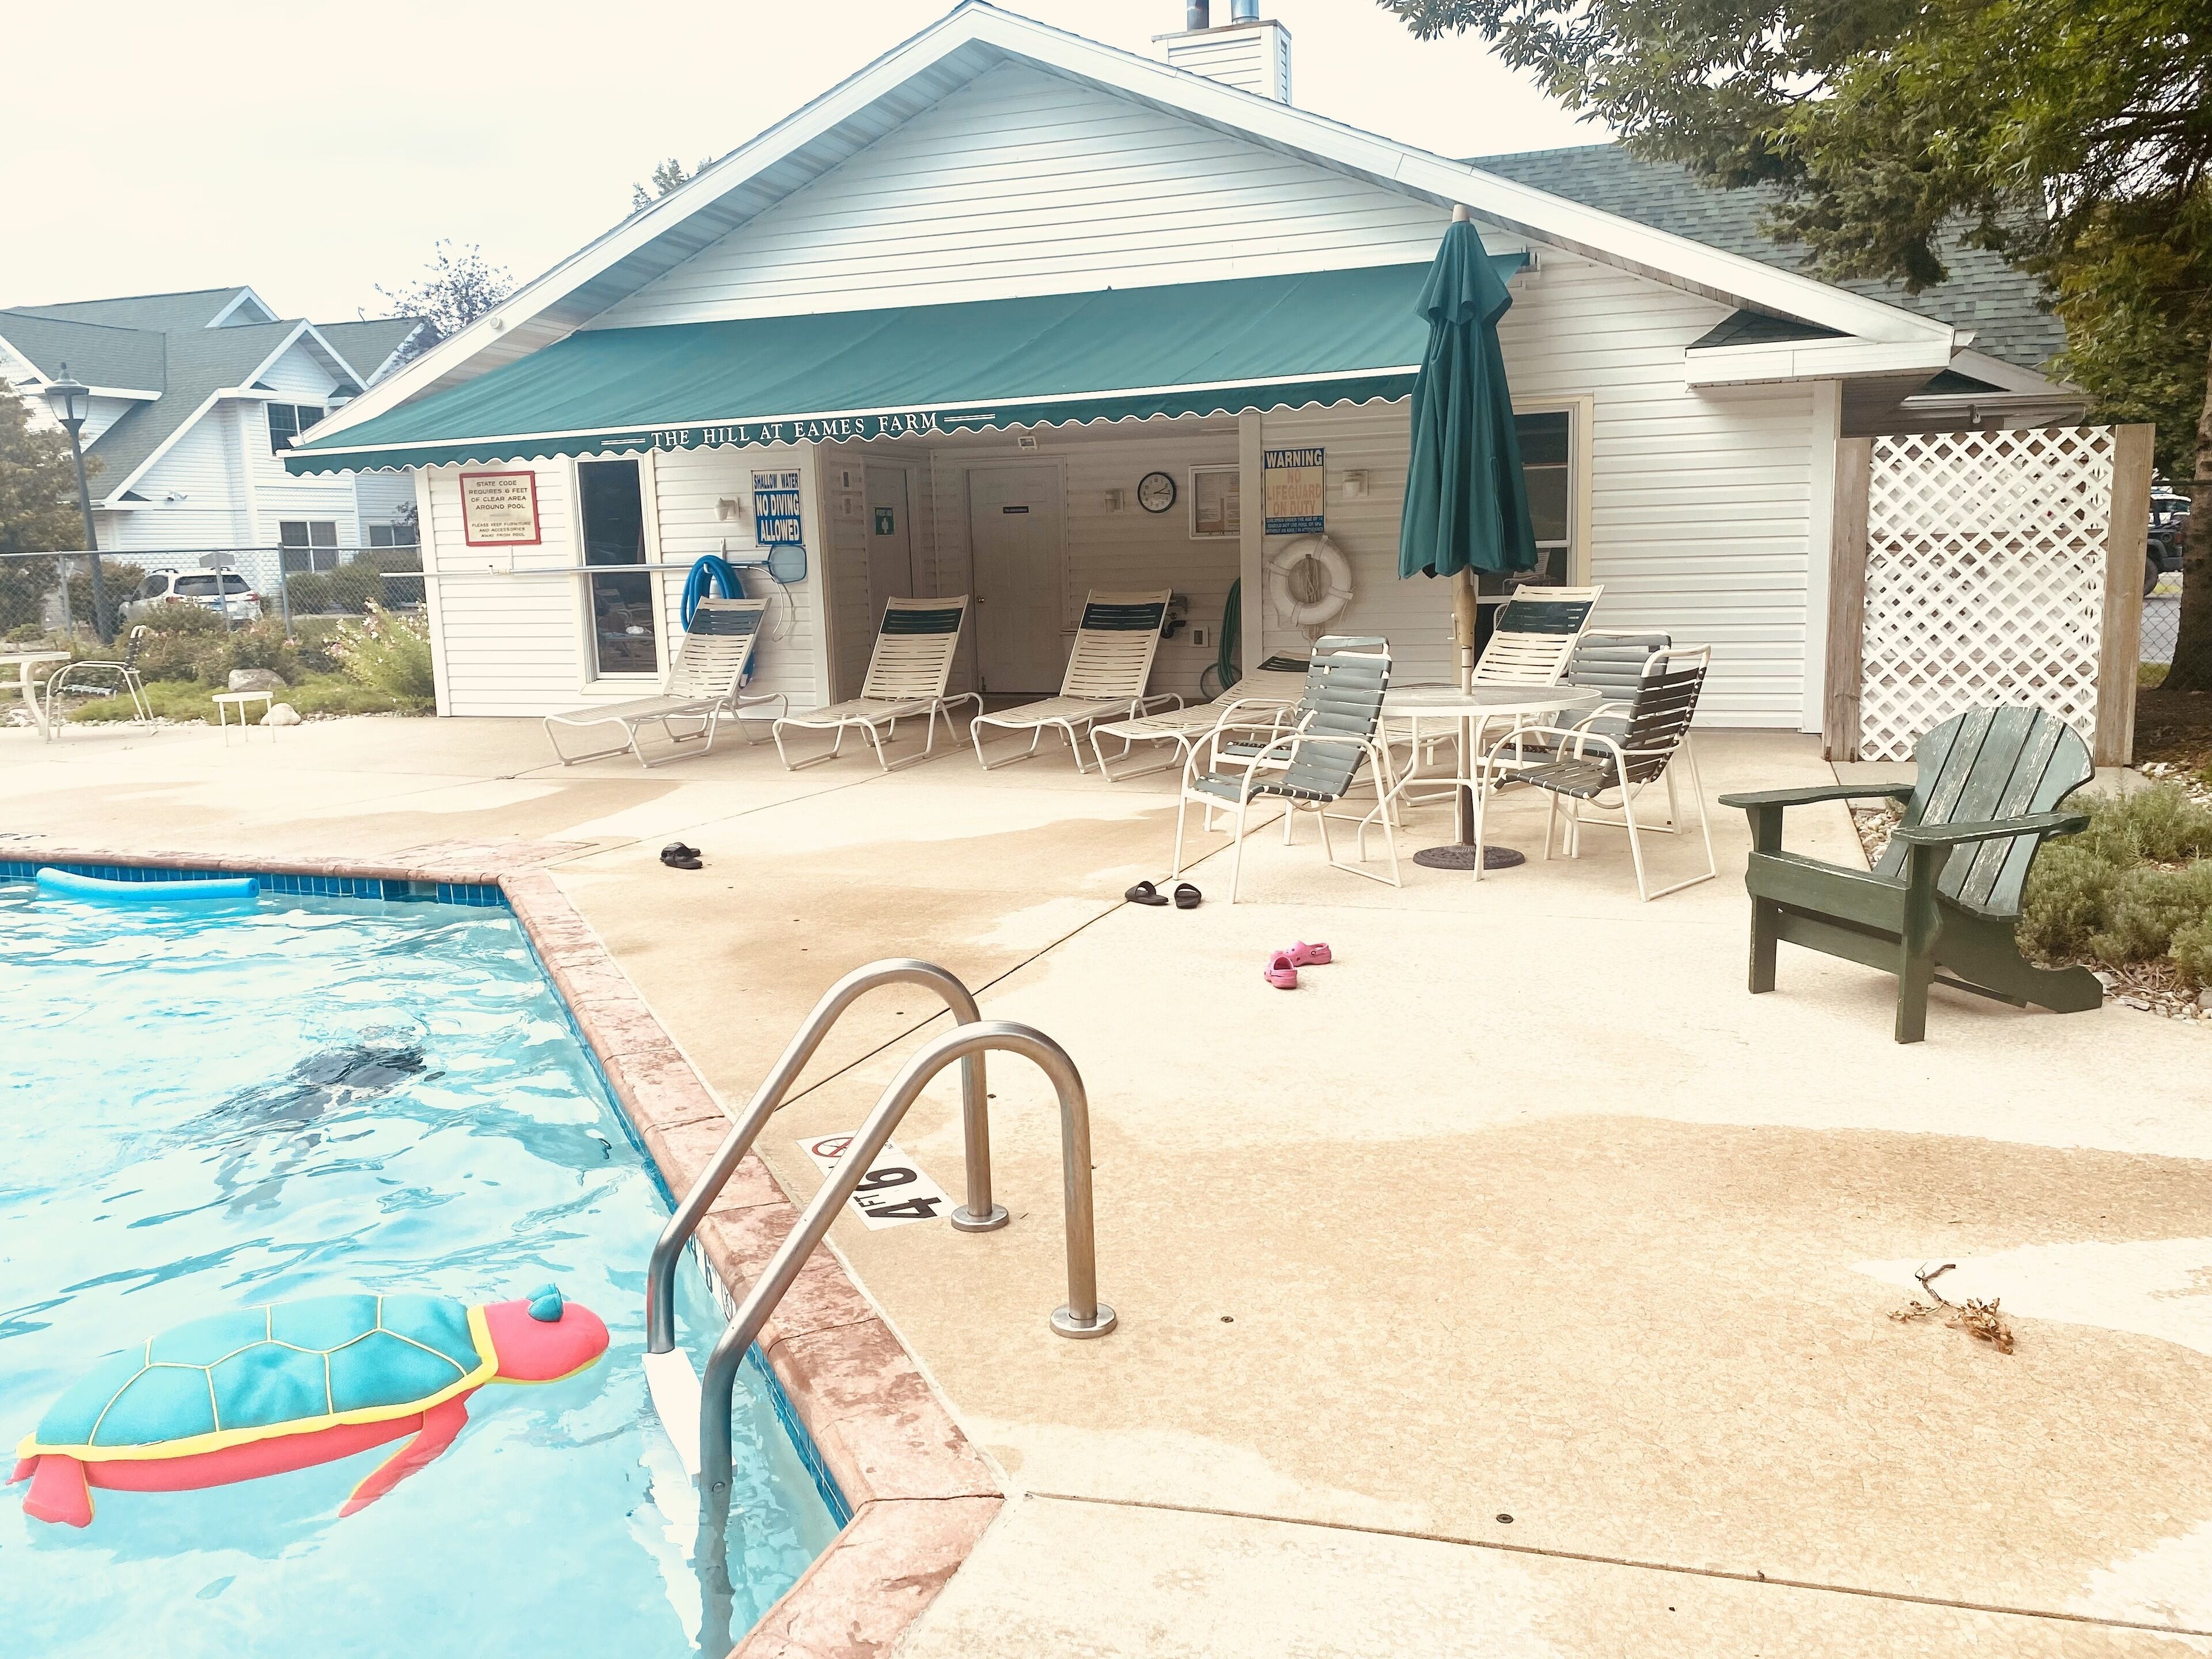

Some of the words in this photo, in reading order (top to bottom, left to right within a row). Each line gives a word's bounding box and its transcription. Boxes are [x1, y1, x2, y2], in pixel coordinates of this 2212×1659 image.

[651, 430, 690, 448] THE
[703, 426, 750, 444] HILL
[760, 424, 782, 440] AT
[794, 419, 865, 438] EAMES
[878, 412, 938, 433] FARM
[1266, 450, 1323, 468] WARNING
[754, 474, 777, 489] SHALLOW
[781, 474, 798, 488] WATER
[1287, 469, 1301, 483] NO
[1267, 484, 1321, 501] LIFEGUARD
[756, 494, 768, 517] NO
[770, 494, 800, 516] DIVING
[1273, 501, 1286, 516] ON
[1290, 500, 1315, 515] DUTY
[761, 519, 800, 541] ALLOWED
[856, 1168, 917, 1191] 6
[853, 1194, 886, 1207] FT
[865, 1196, 942, 1218] 4
